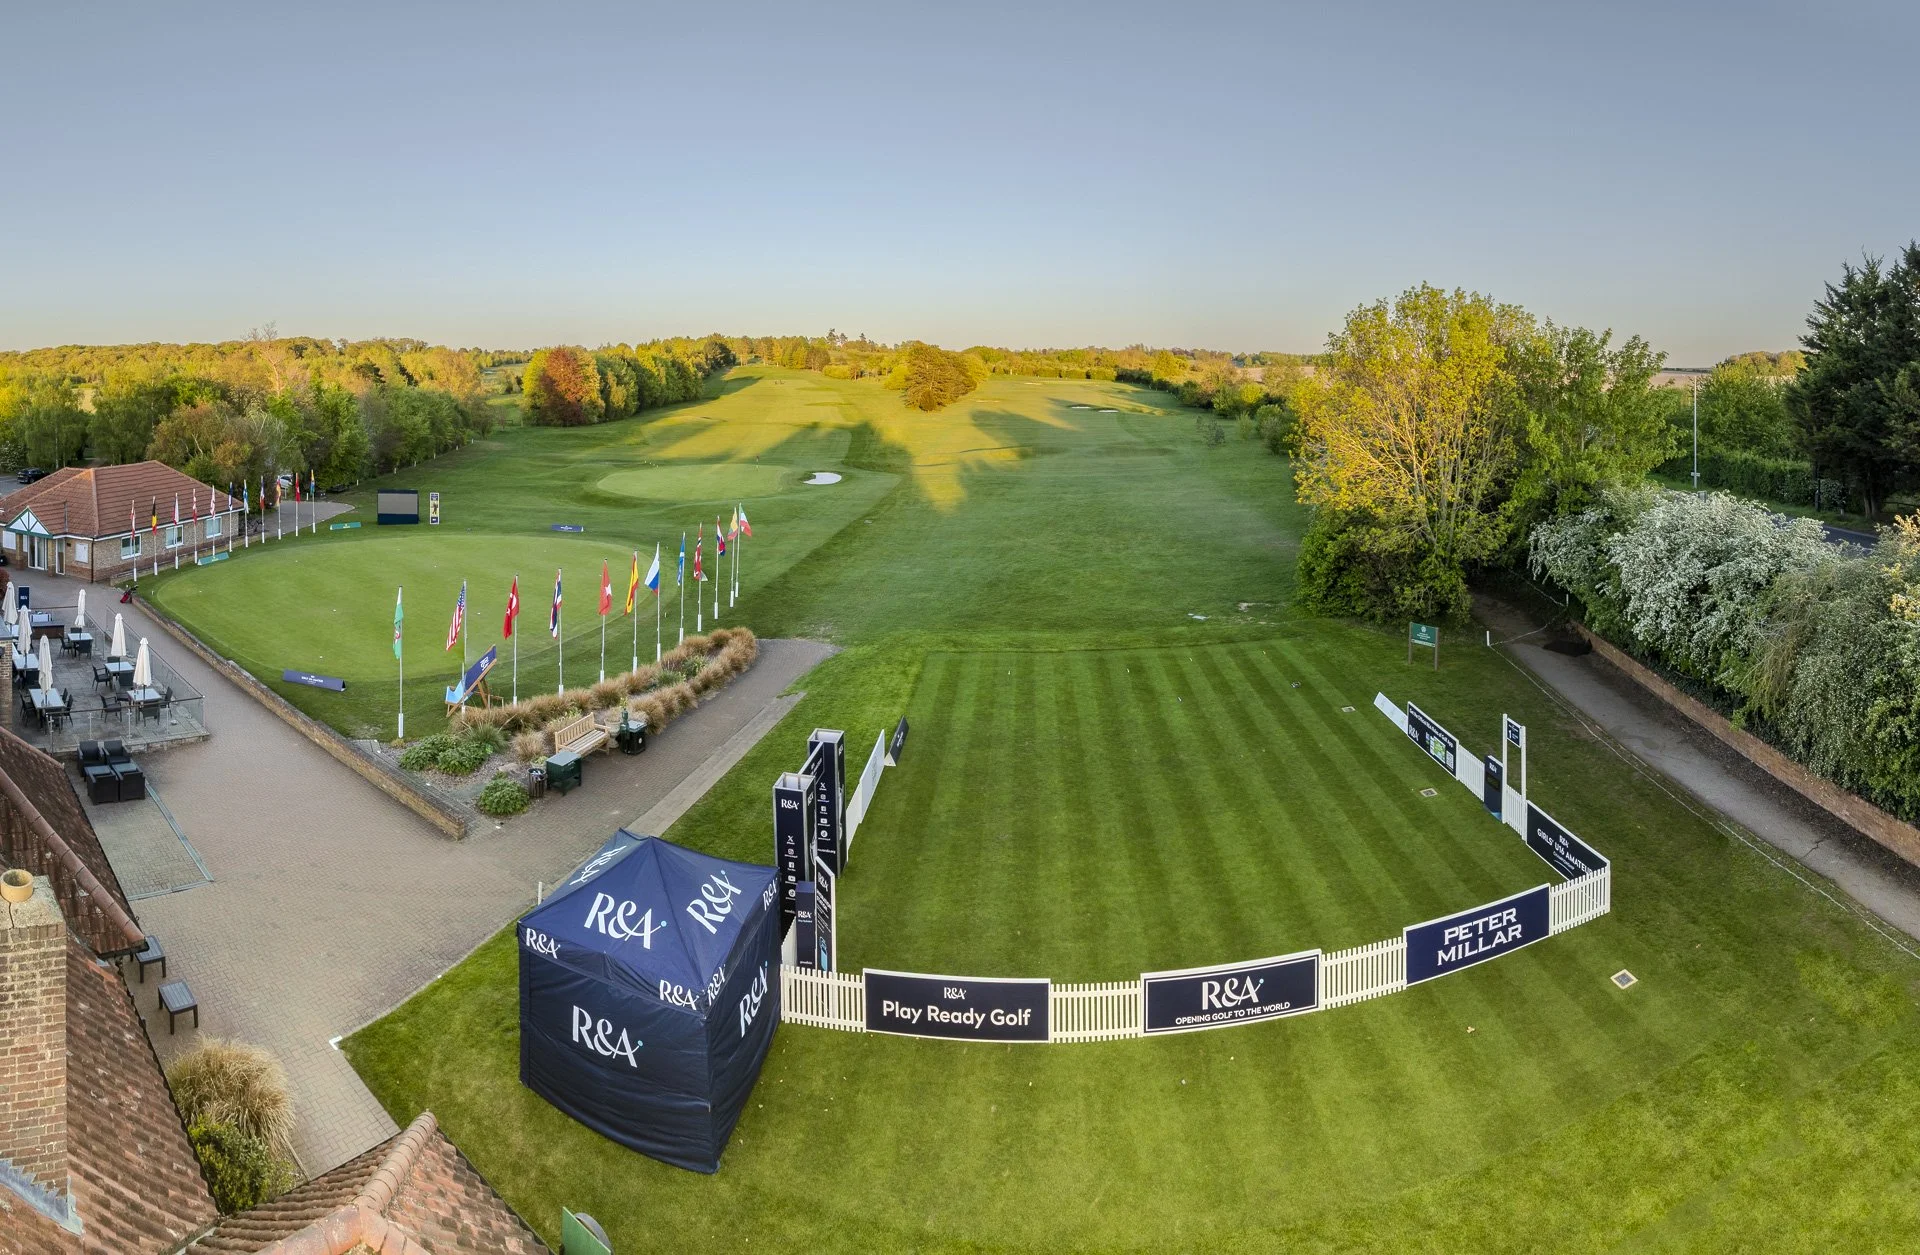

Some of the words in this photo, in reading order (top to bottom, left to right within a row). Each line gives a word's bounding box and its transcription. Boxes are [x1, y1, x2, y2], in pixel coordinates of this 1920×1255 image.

[781, 798, 799, 810] R&A
[1537, 828, 1554, 846] GIRLS'
[1554, 842, 1565, 855] U16
[686, 870, 742, 934] R&A
[762, 877, 780, 911] R&A
[584, 892, 667, 950] R&A
[797, 910, 812, 918] R&A
[1444, 908, 1516, 945] PETER
[525, 928, 561, 959] R&A
[1437, 924, 1522, 966] MILLAR
[659, 979, 699, 1010] R&A
[707, 964, 726, 1006] R&A
[739, 960, 768, 1038] R&A
[944, 987, 966, 1000] R&A
[1202, 976, 1264, 1010] R&A
[883, 1000, 922, 1023] Play
[927, 1005, 986, 1029] Ready
[990, 1008, 1031, 1026] Golf
[1175, 1014, 1211, 1025] OPENING
[1212, 1011, 1233, 1020] GOLF
[1234, 1010, 1245, 1018] TO
[1246, 1007, 1261, 1015] THE
[1262, 1002, 1290, 1013] WORLD
[572, 1005, 644, 1068] R&A
